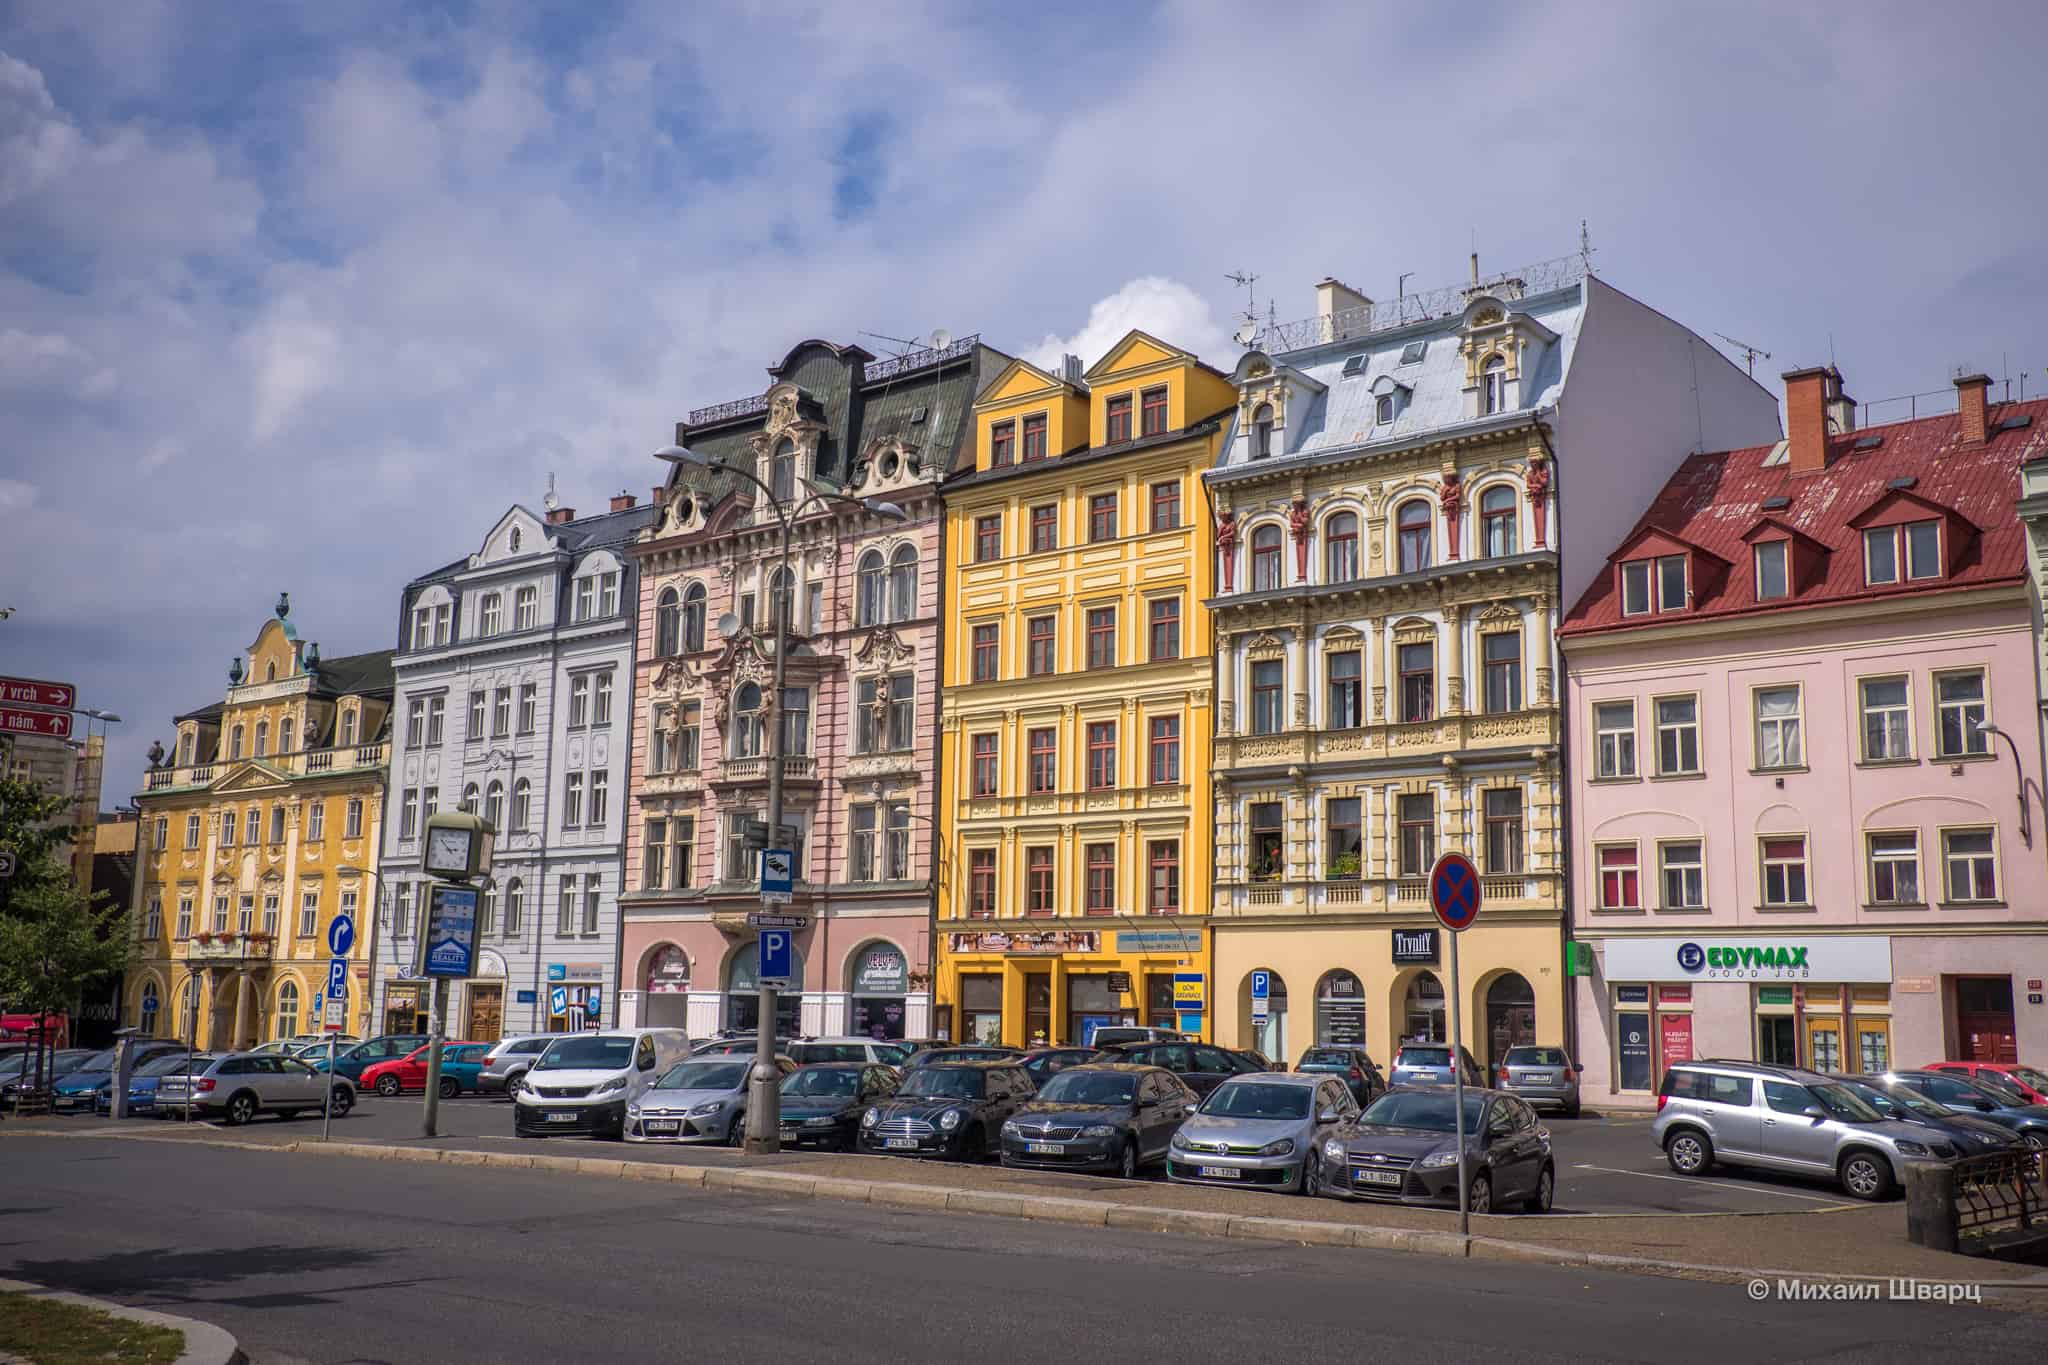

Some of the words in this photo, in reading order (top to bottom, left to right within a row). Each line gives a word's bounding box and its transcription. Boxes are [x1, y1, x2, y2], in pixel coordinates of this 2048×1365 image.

[11, 686, 37, 701] vrch
[8, 713, 37, 730] nám.
[767, 934, 784, 961] P
[1707, 947, 1808, 969] EDYMAX
[331, 963, 344, 987] P
[1708, 969, 1759, 978] GOOD
[1775, 969, 1809, 978] JOB
[1255, 975, 1266, 991] P
